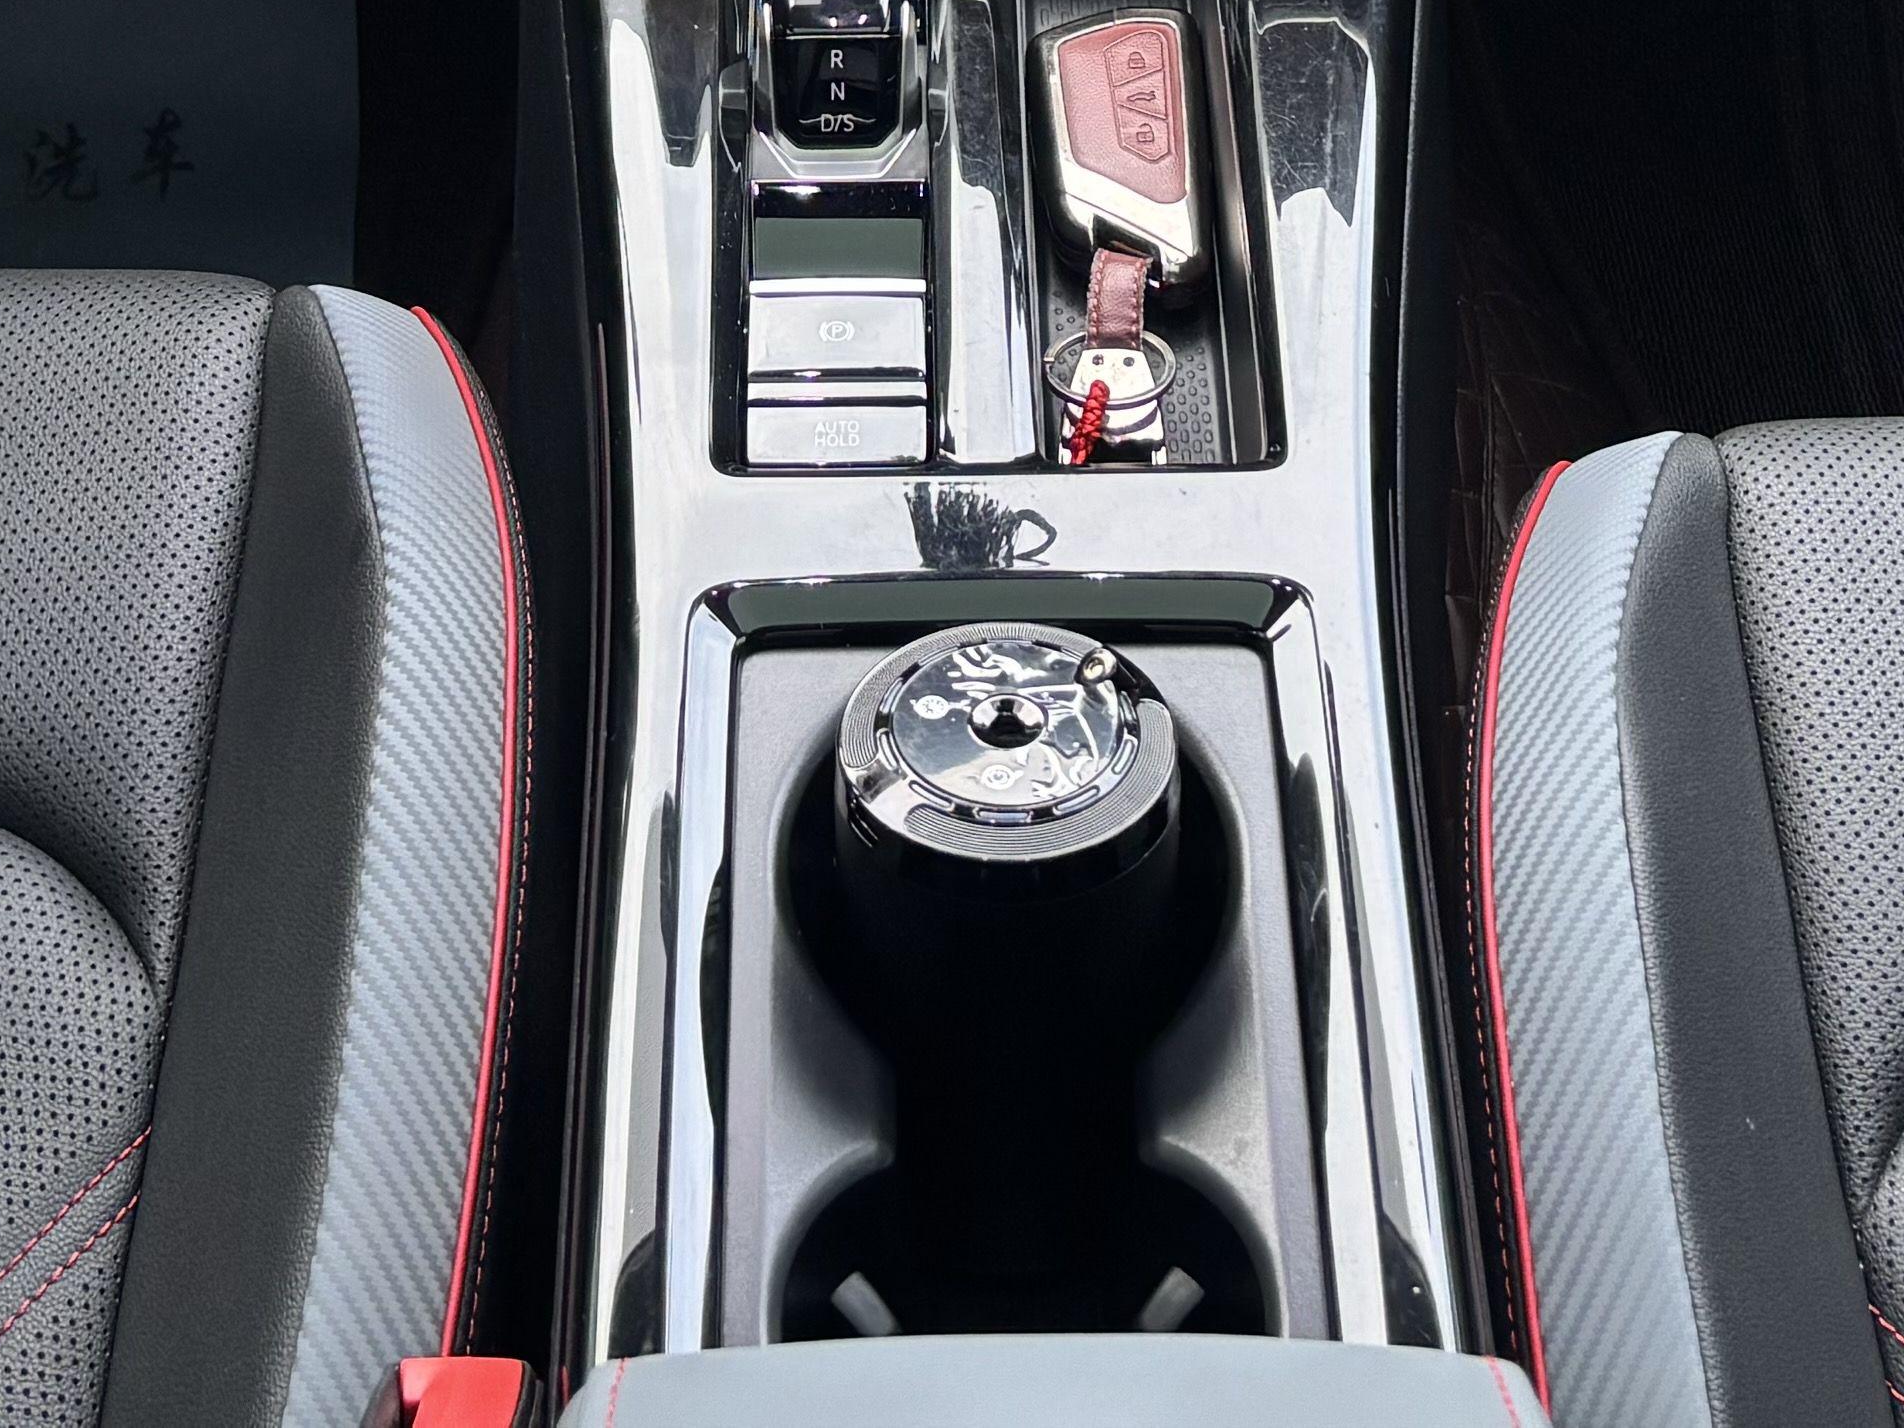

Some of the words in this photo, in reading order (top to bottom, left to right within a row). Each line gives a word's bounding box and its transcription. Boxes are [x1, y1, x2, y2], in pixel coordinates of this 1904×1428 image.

[830, 49, 844, 69] R
[830, 81, 845, 101] N
[820, 113, 855, 132] D/S
[814, 420, 860, 433] AUTO
[814, 433, 861, 447] HOLD
